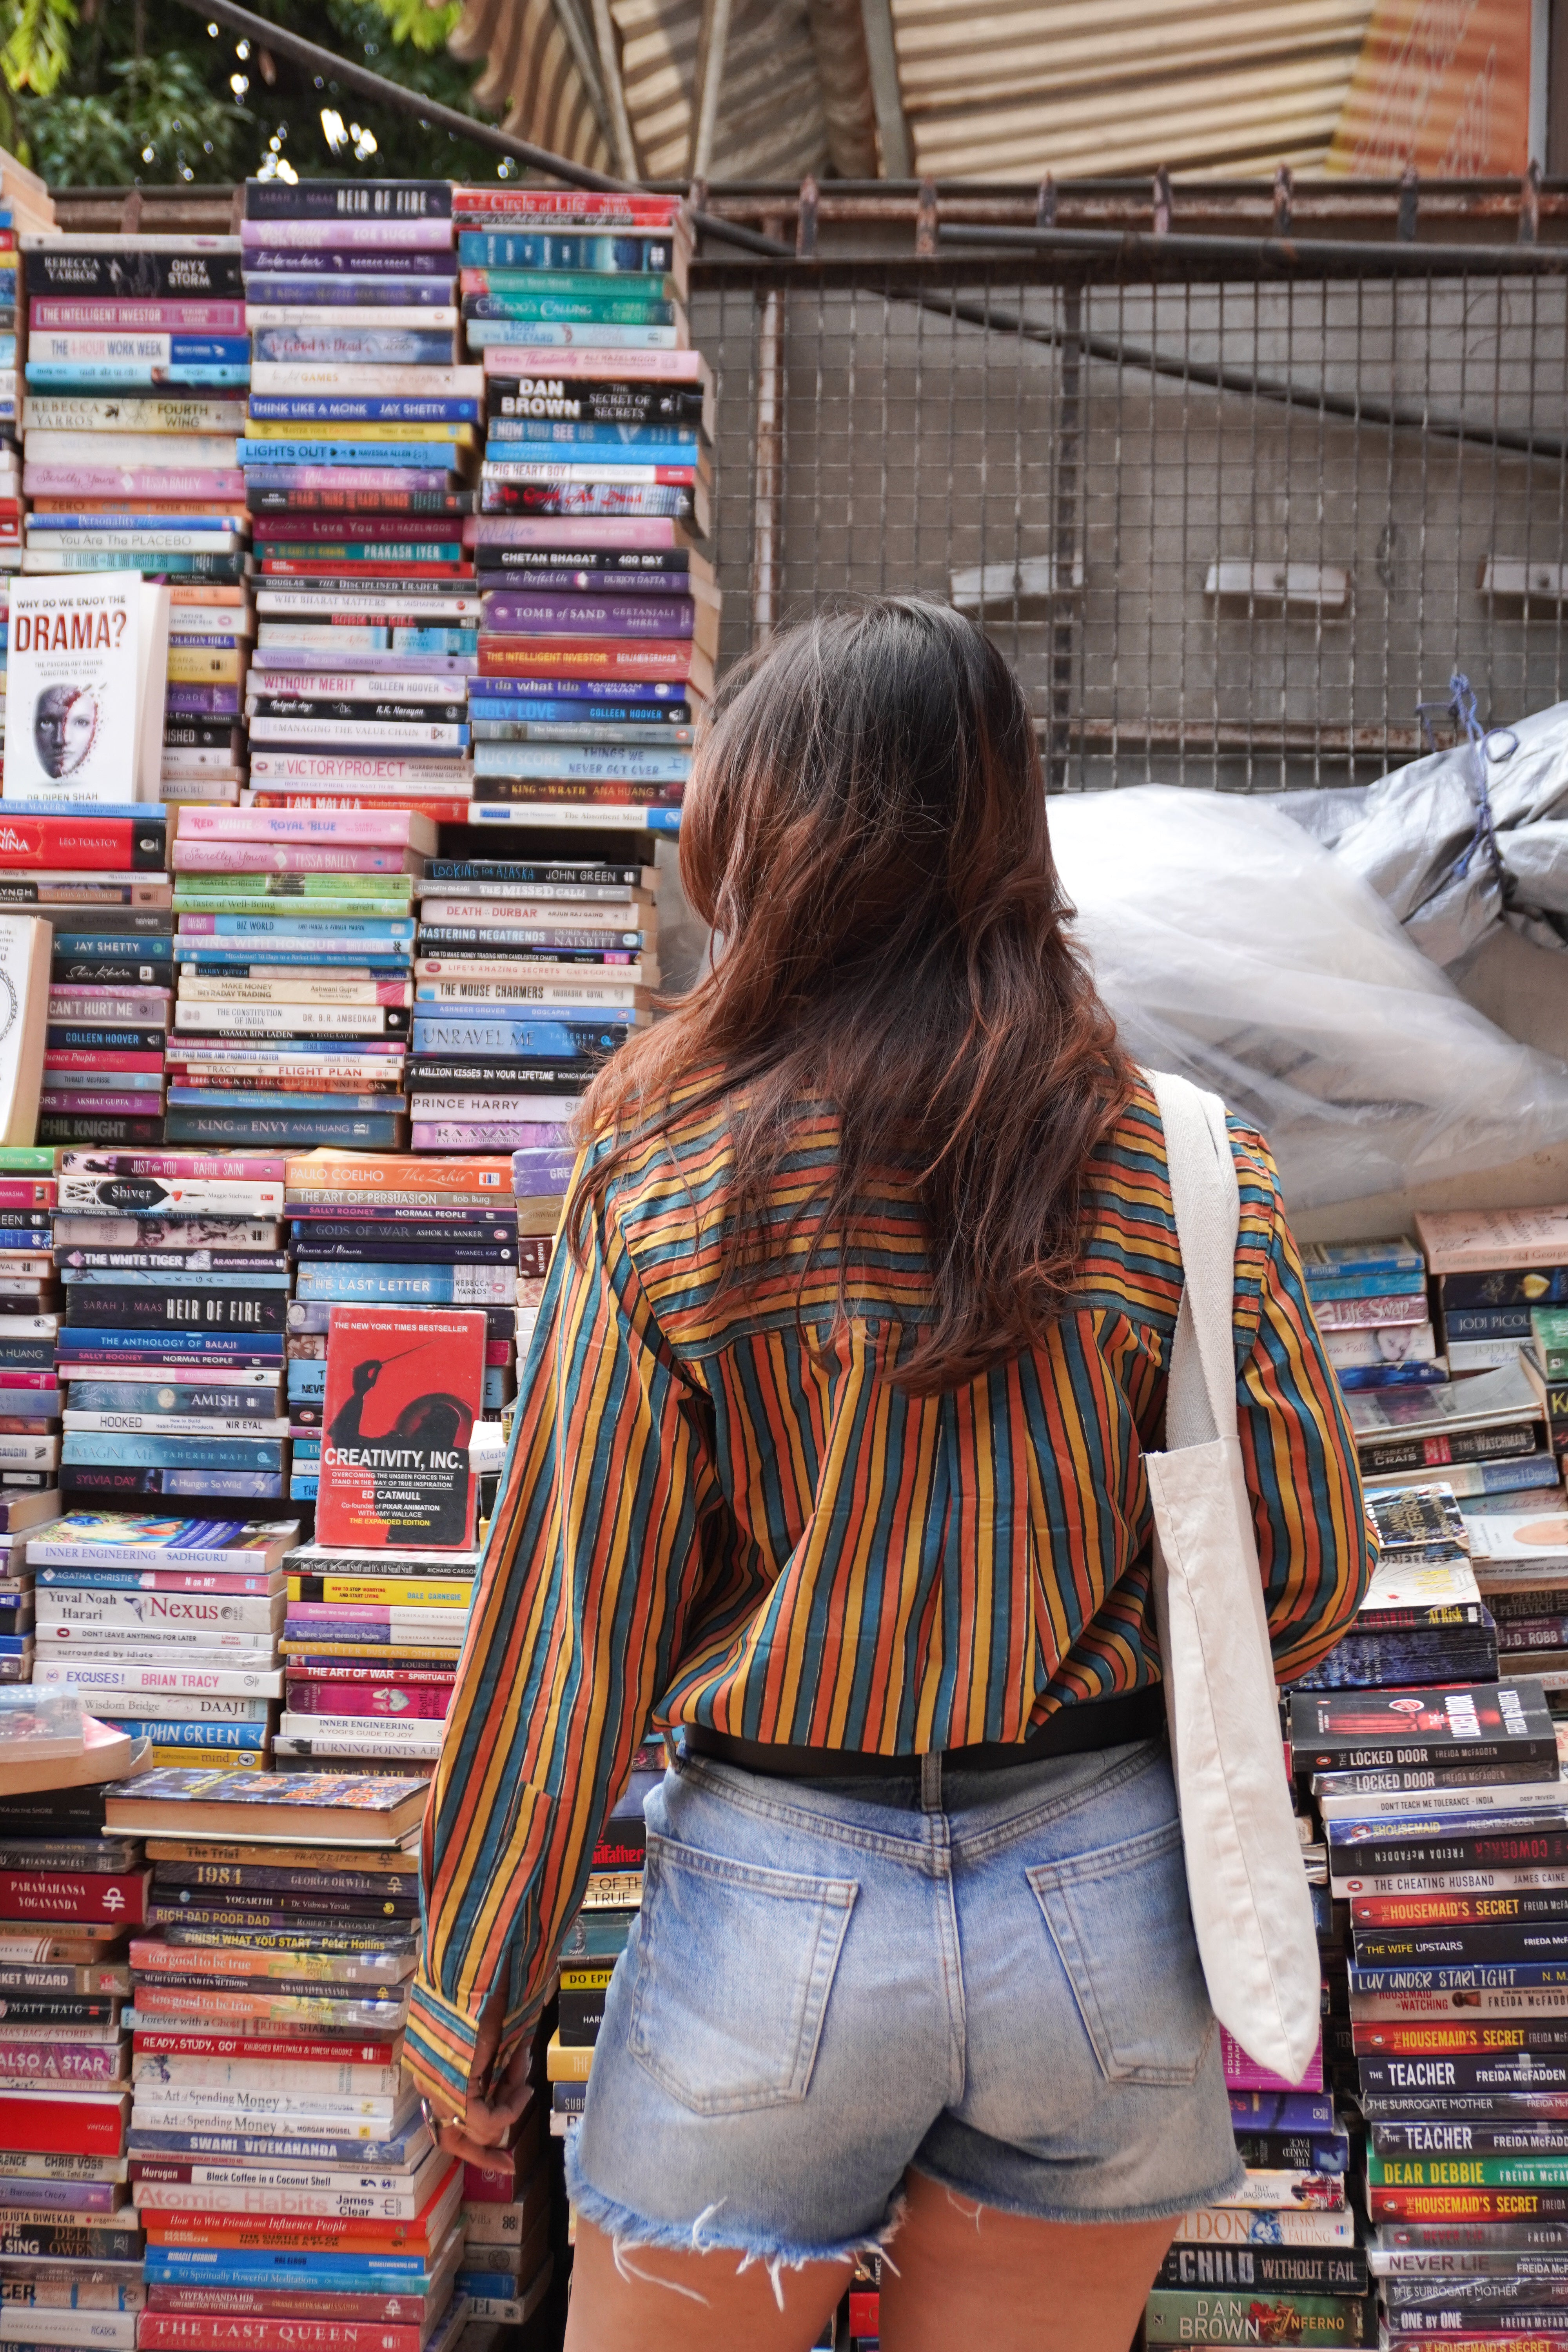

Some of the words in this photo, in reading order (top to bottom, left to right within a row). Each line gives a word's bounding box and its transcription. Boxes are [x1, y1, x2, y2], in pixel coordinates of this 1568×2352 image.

[519, 379, 564, 398] DAN
[253, 402, 289, 414] THINK
[292, 403, 314, 414] LIKE
[318, 403, 327, 414] A
[330, 403, 366, 414] MONK
[501, 397, 581, 416] BROWN
[245, 445, 295, 456] LIGHTS
[299, 446, 327, 457] OUT
[59, 534, 80, 546] You
[83, 535, 102, 545] Are
[107, 534, 127, 545] The
[132, 535, 191, 545] PLACEBO
[502, 554, 547, 563] CHETAN
[550, 554, 597, 563] BHAGAT
[17, 601, 39, 609] WHY
[59, 598, 73, 606] WE
[76, 597, 105, 606] ENJOY
[515, 608, 552, 617] TOMB
[557, 608, 569, 619] of
[570, 609, 606, 619] SAND
[15, 610, 127, 652] DRAMA?
[264, 677, 316, 691] WITHOUT
[319, 679, 355, 691] MERIT
[59, 837, 75, 846] LEO
[78, 837, 117, 848] TOLSTOY
[440, 983, 456, 995] THE
[460, 984, 490, 996] MOUSE
[495, 985, 543, 999] CHARMERS
[49, 1001, 80, 1014] CAN'T
[84, 1002, 113, 1014] HURT
[116, 1003, 132, 1015] ME
[217, 1008, 230, 1016] THE
[319, 1014, 333, 1022] B.R.
[337, 1014, 376, 1023] AMBEDKAR
[419, 1067, 451, 1076] MILLION
[454, 1069, 481, 1077] KISSES
[495, 1071, 515, 1079] YOUR
[518, 1071, 554, 1080] LIFETIME
[413, 1099, 465, 1108] PRINCE
[472, 1100, 519, 1109] HARRY
[131, 1160, 149, 1173] JUST
[151, 1162, 161, 1173] for
[163, 1161, 176, 1174] YOU
[194, 1162, 218, 1175] RAHUL
[223, 1163, 243, 1176] SAINI
[291, 1169, 327, 1180] PAULO
[332, 1169, 383, 1181] COELHO
[111, 1185, 151, 1198] Shiver
[299, 1192, 322, 1201] THE
[324, 1192, 344, 1202] ART
[347, 1193, 365, 1202] OF
[367, 1193, 437, 1204] PERSUASION
[453, 1194, 469, 1203] Bob
[471, 1195, 490, 1205] Burg
[84, 1254, 106, 1264] THE
[109, 1254, 147, 1265] WHITE
[150, 1255, 182, 1265] TIGER
[307, 1280, 333, 1289] THE
[339, 1280, 374, 1290] LAST
[379, 1281, 430, 1290] LETTER
[167, 1299, 199, 1320] HEIR
[207, 1301, 222, 1320] OF
[230, 1301, 261, 1321] FIRE
[122, 1338, 183, 1347] ANTHOLOGY
[325, 1448, 426, 1470] CREATIVITY,
[430, 1451, 463, 1468] INC.
[1375, 1454, 1417, 1465] CRAIS
[377, 1492, 420, 1500] CATMULL
[45, 1548, 79, 1557] INNER
[82, 1549, 156, 1560] ENGINEERING
[49, 1591, 82, 1603] Yuval
[85, 1593, 116, 1604] Noah
[62, 1608, 103, 1619] Harari
[149, 1597, 218, 1619] Nexus
[1506, 1633, 1526, 1646] J.D.
[1529, 1630, 1558, 1643] ROBB
[329, 1668, 350, 1677] ART
[370, 1670, 394, 1679] WAR
[136, 1722, 179, 1741] JOHN
[184, 1726, 239, 1744] GREEN
[1350, 1751, 1394, 1766] LOCKED
[1397, 1749, 1428, 1763] DOOR
[1375, 1879, 1392, 1891] THE
[1397, 1877, 1445, 1890] CHEATING
[1450, 1875, 1494, 1887] HUSBAND
[1390, 1901, 1469, 1919] HOUSEMAID'S
[1476, 1899, 1519, 1916] SECRET
[1359, 1975, 1384, 1990] LUV
[1390, 1973, 1432, 1988] UNDER
[1439, 1969, 1516, 1988] STARLIGHT
[1388, 2063, 1455, 2085] TEACHER
[1476, 2071, 1511, 2082] FREIDA
[1513, 2069, 1566, 2082] McFADDEN
[1385, 2163, 1423, 2184] DEAR
[1430, 2163, 1485, 2183] DEBBIE
[336, 2195, 374, 2207] James
[339, 2206, 370, 2217] Clear
[1179, 2250, 1254, 2283] CHILD
[1261, 2258, 1323, 2280] WITHOUT
[1328, 2261, 1357, 2281] FAIL
[1197, 2300, 1242, 2317] DAN
[156, 2322, 201, 2335] THE
[214, 2323, 269, 2338] LAST
[279, 2326, 358, 2341] QUEEN
[1179, 2318, 1259, 2340] BROWN
